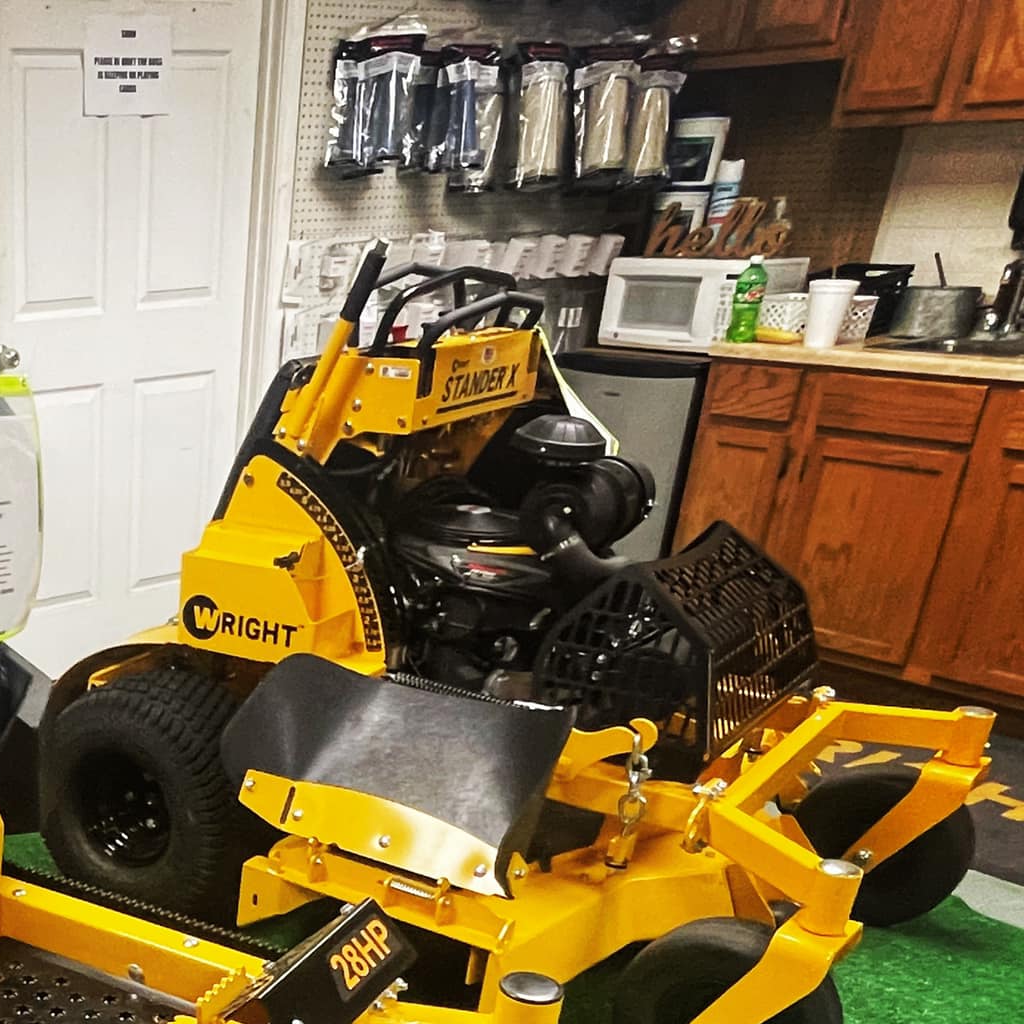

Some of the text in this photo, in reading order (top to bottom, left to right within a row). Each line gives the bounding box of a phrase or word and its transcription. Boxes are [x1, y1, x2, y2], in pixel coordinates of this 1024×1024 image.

[643, 201, 792, 258] hello
[442, 366, 508, 402] STANDER
[506, 363, 520, 388] X
[182, 595, 298, 648] WRIGHT
[330, 919, 391, 990] 28HP
